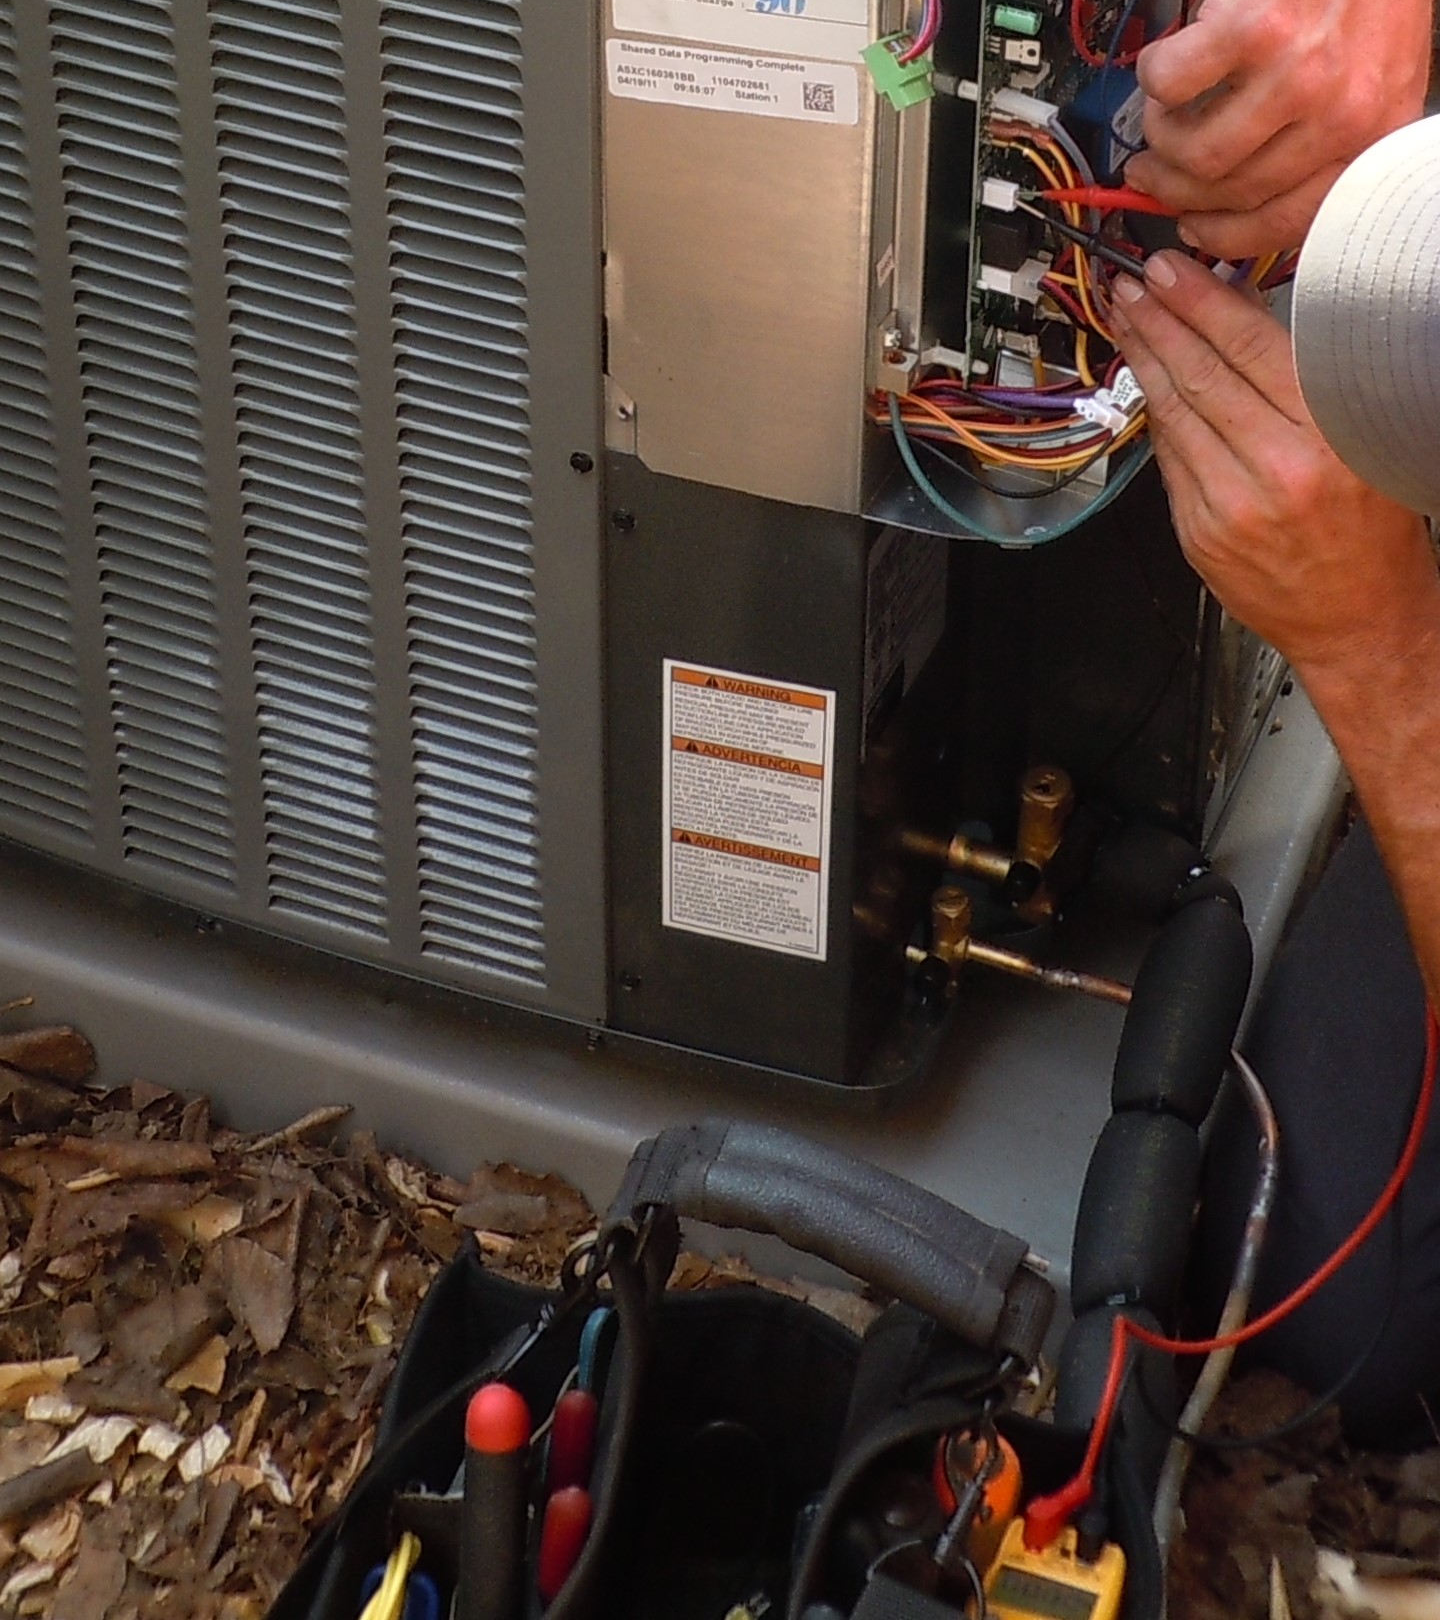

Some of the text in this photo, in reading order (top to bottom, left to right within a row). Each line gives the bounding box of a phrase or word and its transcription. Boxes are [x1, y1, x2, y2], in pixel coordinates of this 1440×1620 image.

[621, 43, 806, 74] Shared Data Programming Complete
[735, 90, 771, 103] Station
[723, 680, 791, 701] WARNING
[702, 745, 800, 773] ADVERTENCIA
[695, 835, 807, 867] AVERTISSEMENT
